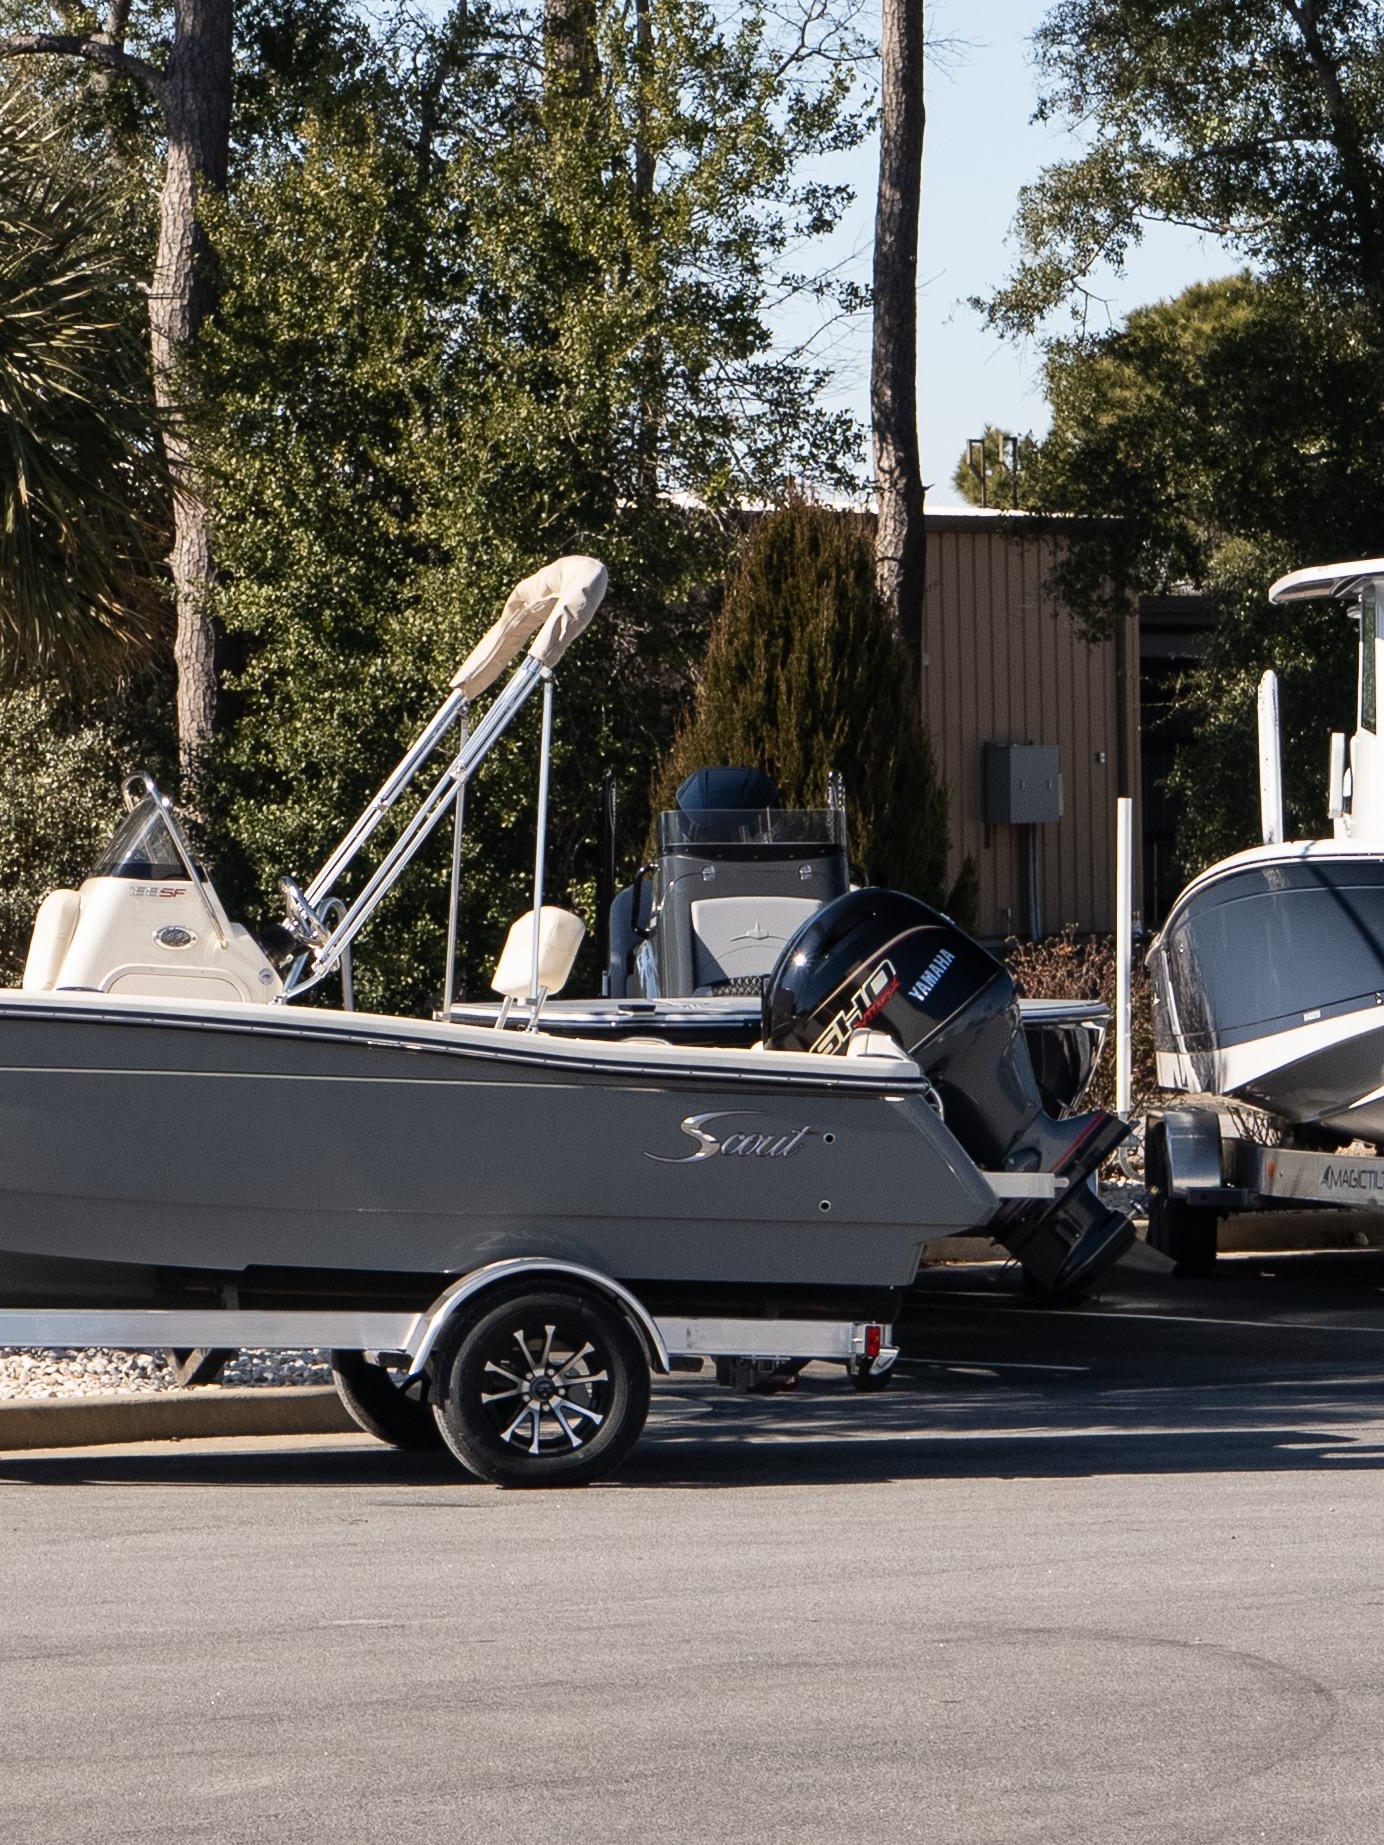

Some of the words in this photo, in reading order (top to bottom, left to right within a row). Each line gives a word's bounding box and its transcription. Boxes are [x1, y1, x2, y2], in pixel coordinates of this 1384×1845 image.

[908, 949, 956, 1002] YAMAHA
[810, 959, 897, 1055] SHO
[643, 1110, 812, 1163] Scout
[1329, 1168, 1384, 1190] MAGICTIL
